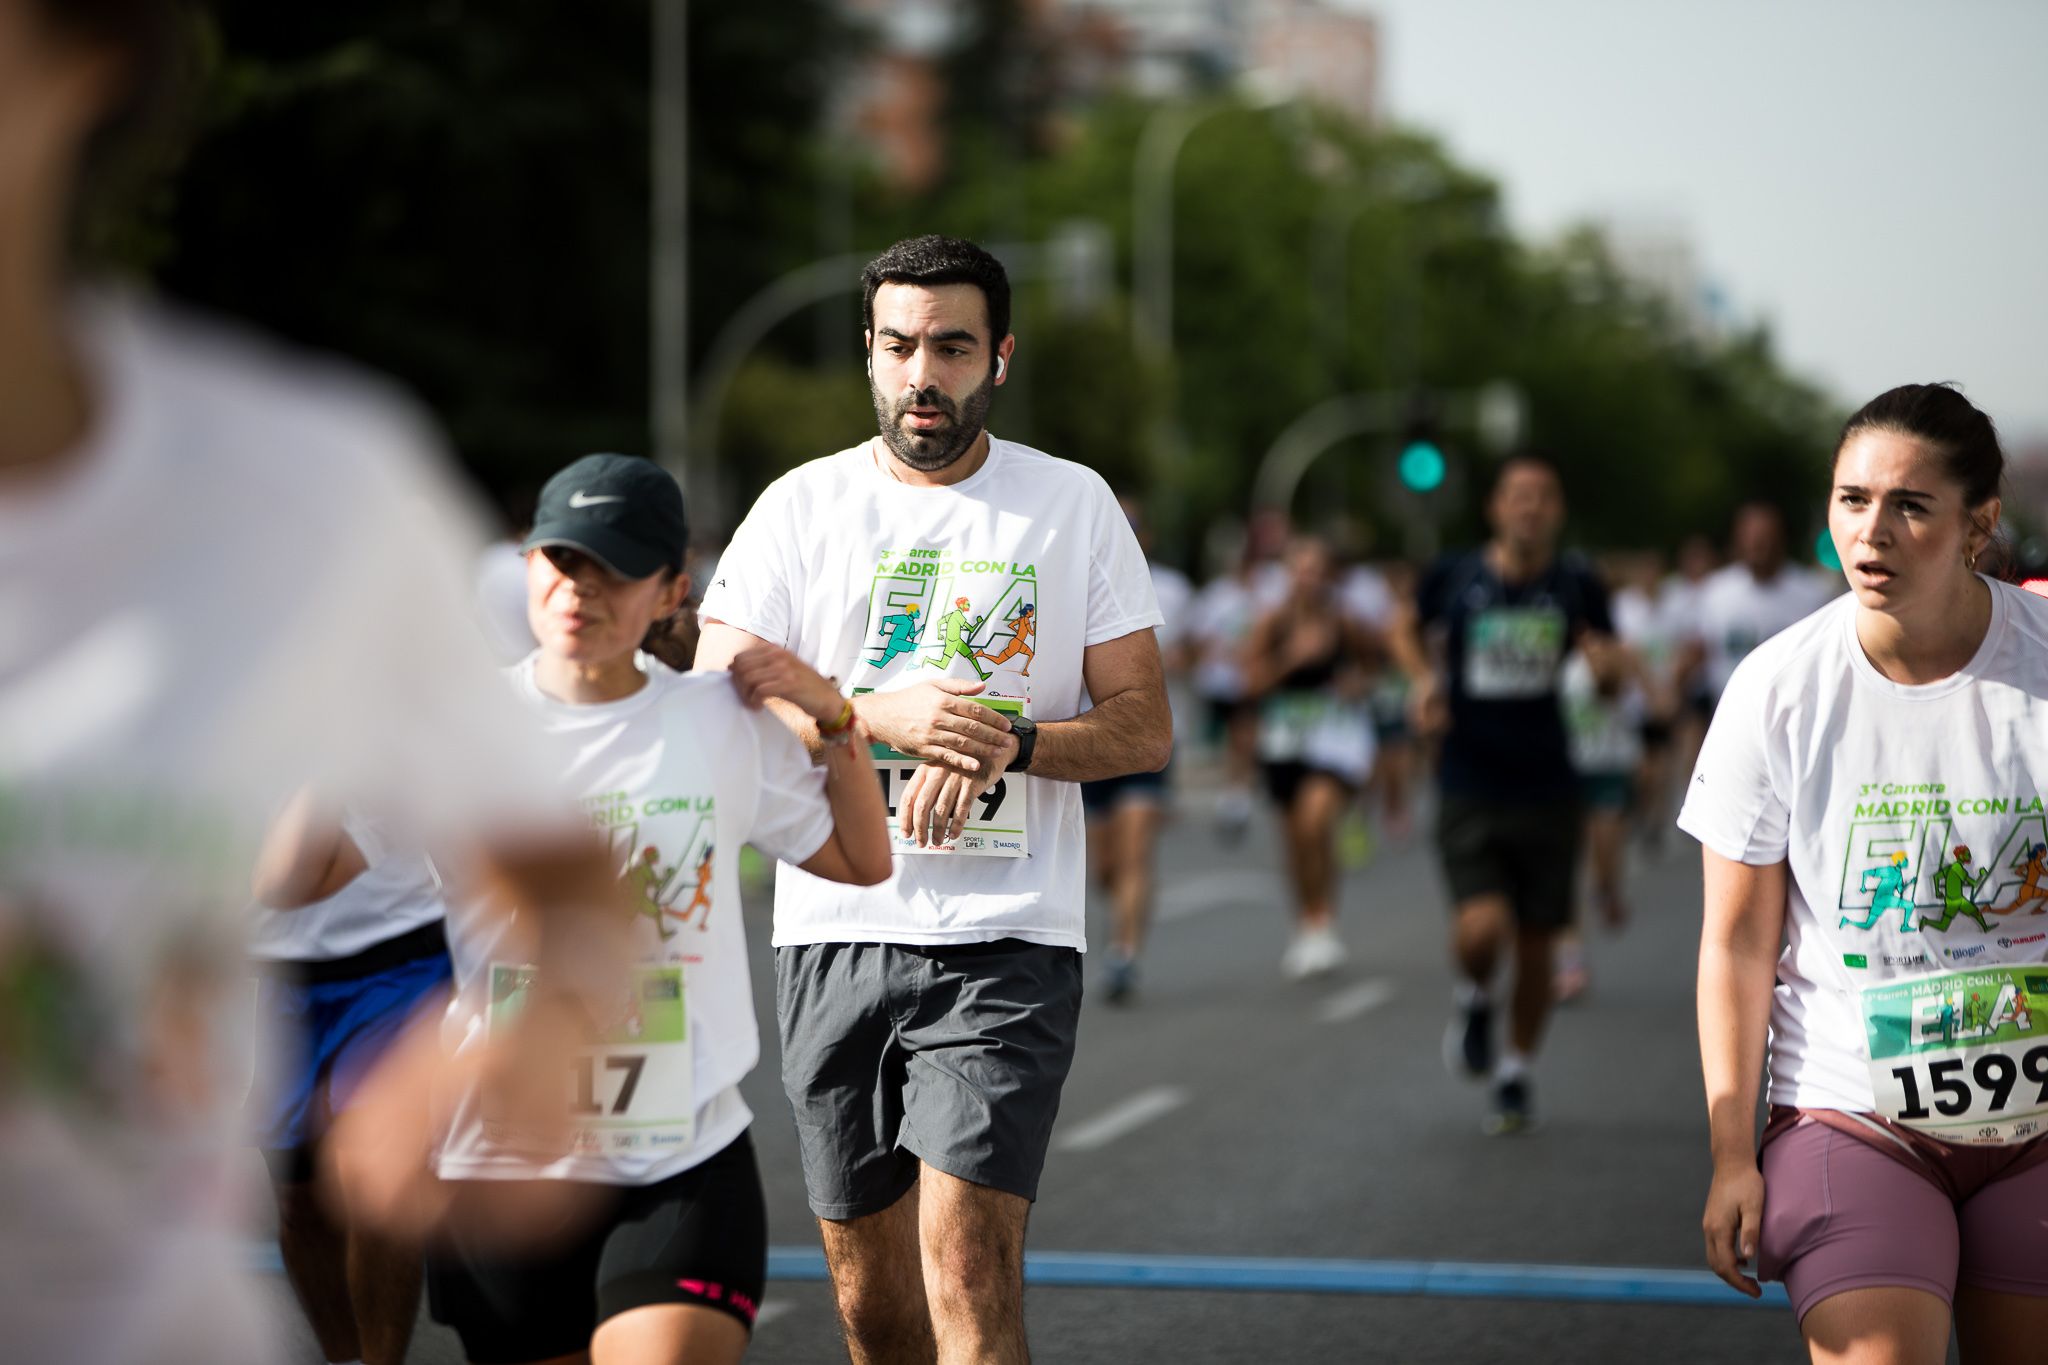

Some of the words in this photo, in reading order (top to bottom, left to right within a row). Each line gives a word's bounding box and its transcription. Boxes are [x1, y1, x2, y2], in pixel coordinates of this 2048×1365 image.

[901, 547, 953, 559] arrera
[876, 561, 955, 577] MADRID
[960, 561, 1006, 574] CON
[1011, 562, 1036, 578] LA
[1882, 783, 1946, 796] Carrera
[643, 797, 690, 817] CON
[1854, 799, 1951, 818] MADRID
[1957, 797, 2009, 815] CON
[2014, 796, 2044, 814] LA
[1952, 944, 1986, 960] Biogen
[1911, 980, 1964, 997] MADRID
[1966, 975, 1994, 987] CON
[1997, 973, 2013, 983] LA
[1892, 1045, 2048, 1120] 1599
